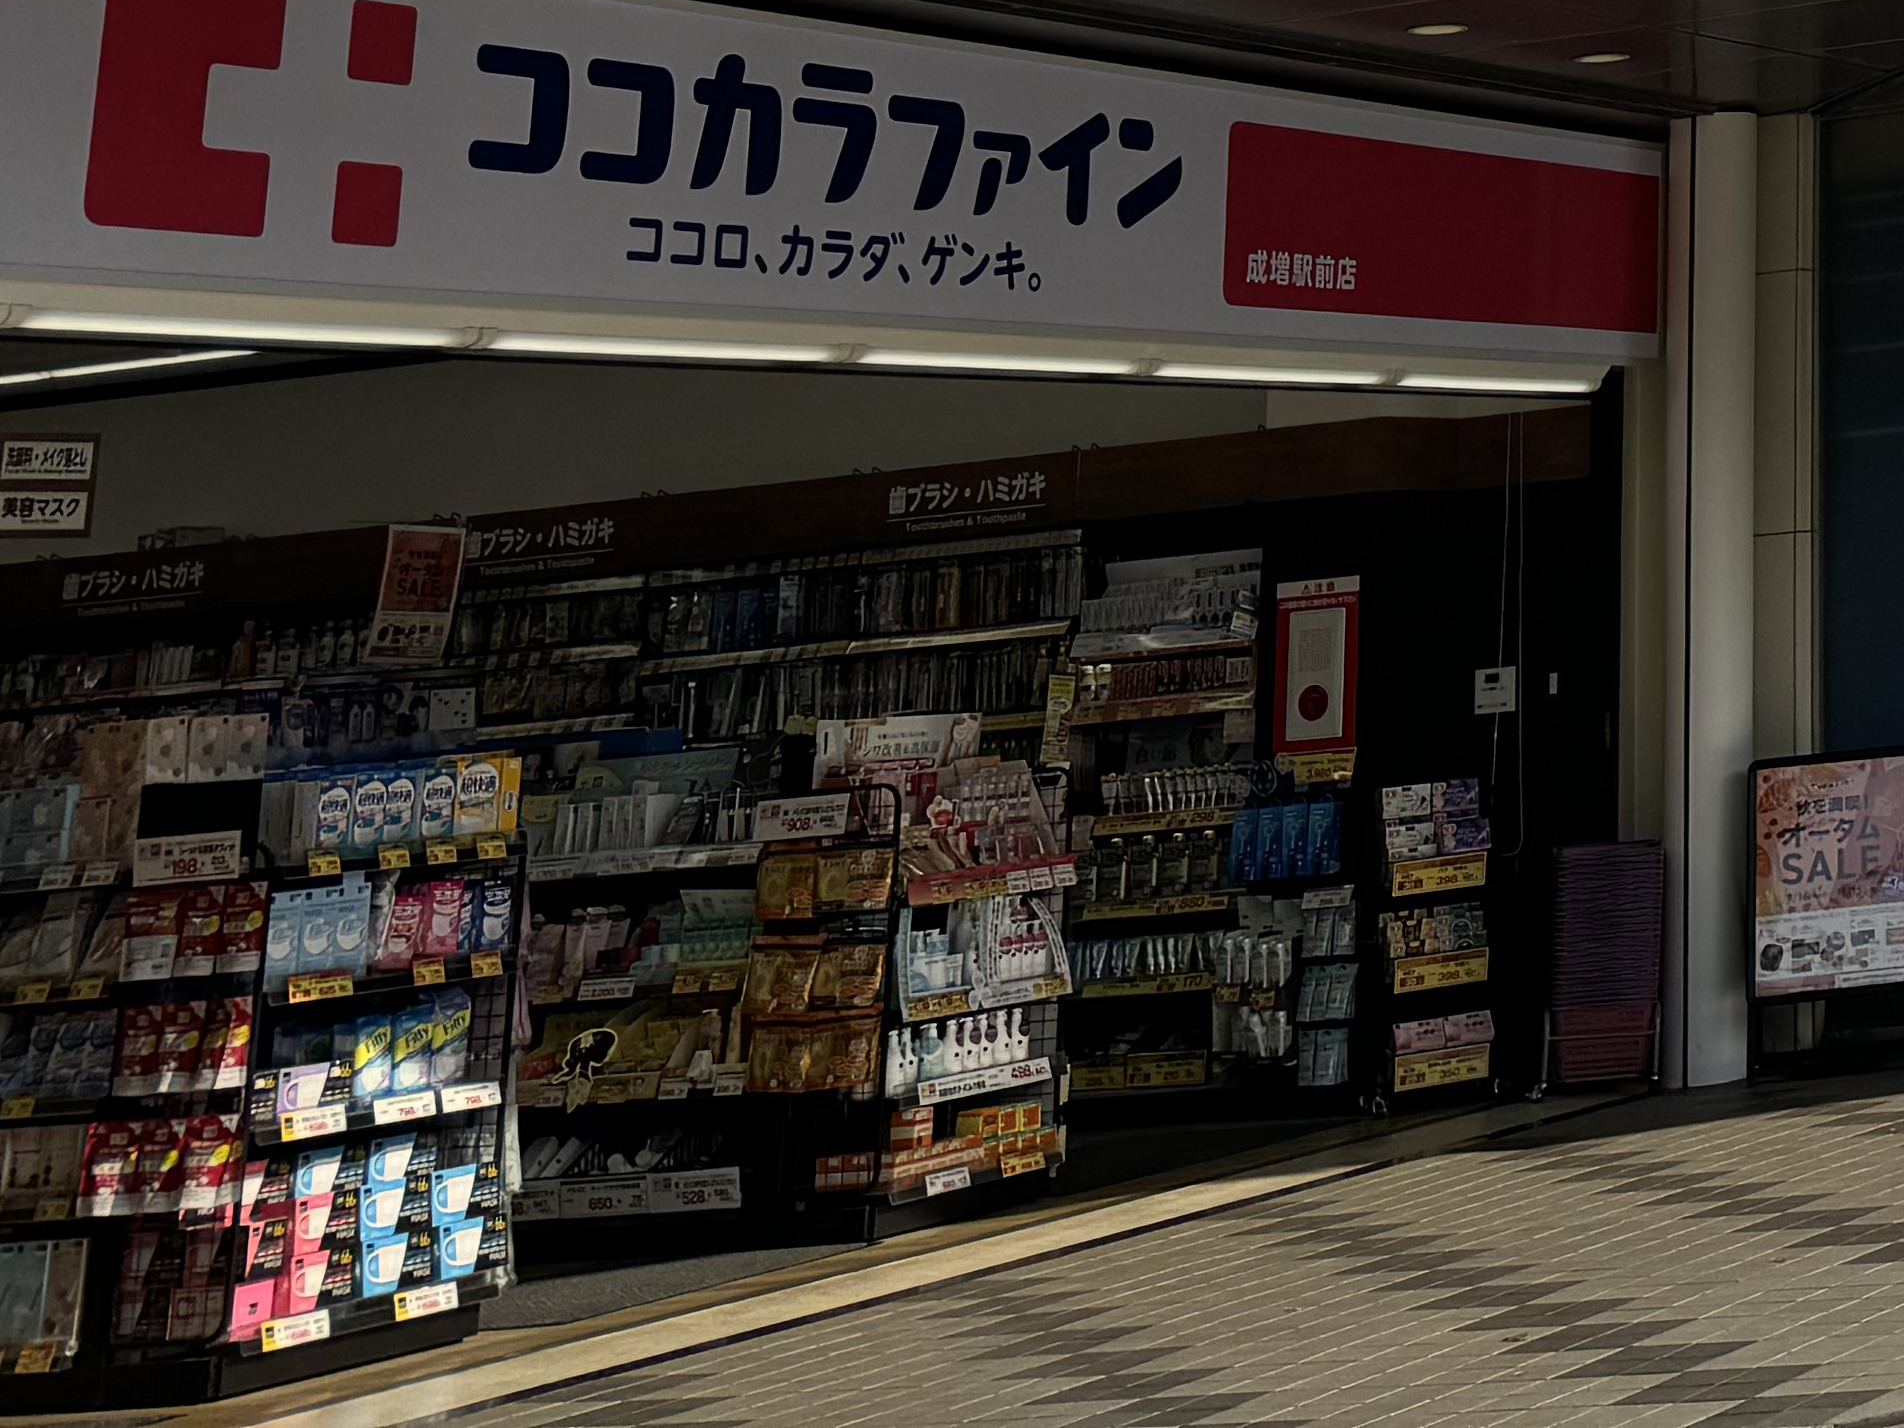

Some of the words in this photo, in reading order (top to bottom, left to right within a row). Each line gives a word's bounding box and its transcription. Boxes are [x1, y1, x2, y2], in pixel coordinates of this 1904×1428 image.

[467, 43, 1183, 229] ココカラファイン
[626, 216, 1042, 293] ココロ、カラダ、ゲンキ。
[1245, 248, 1358, 291] 成増駅前店
[1781, 844, 1881, 886] SALE
